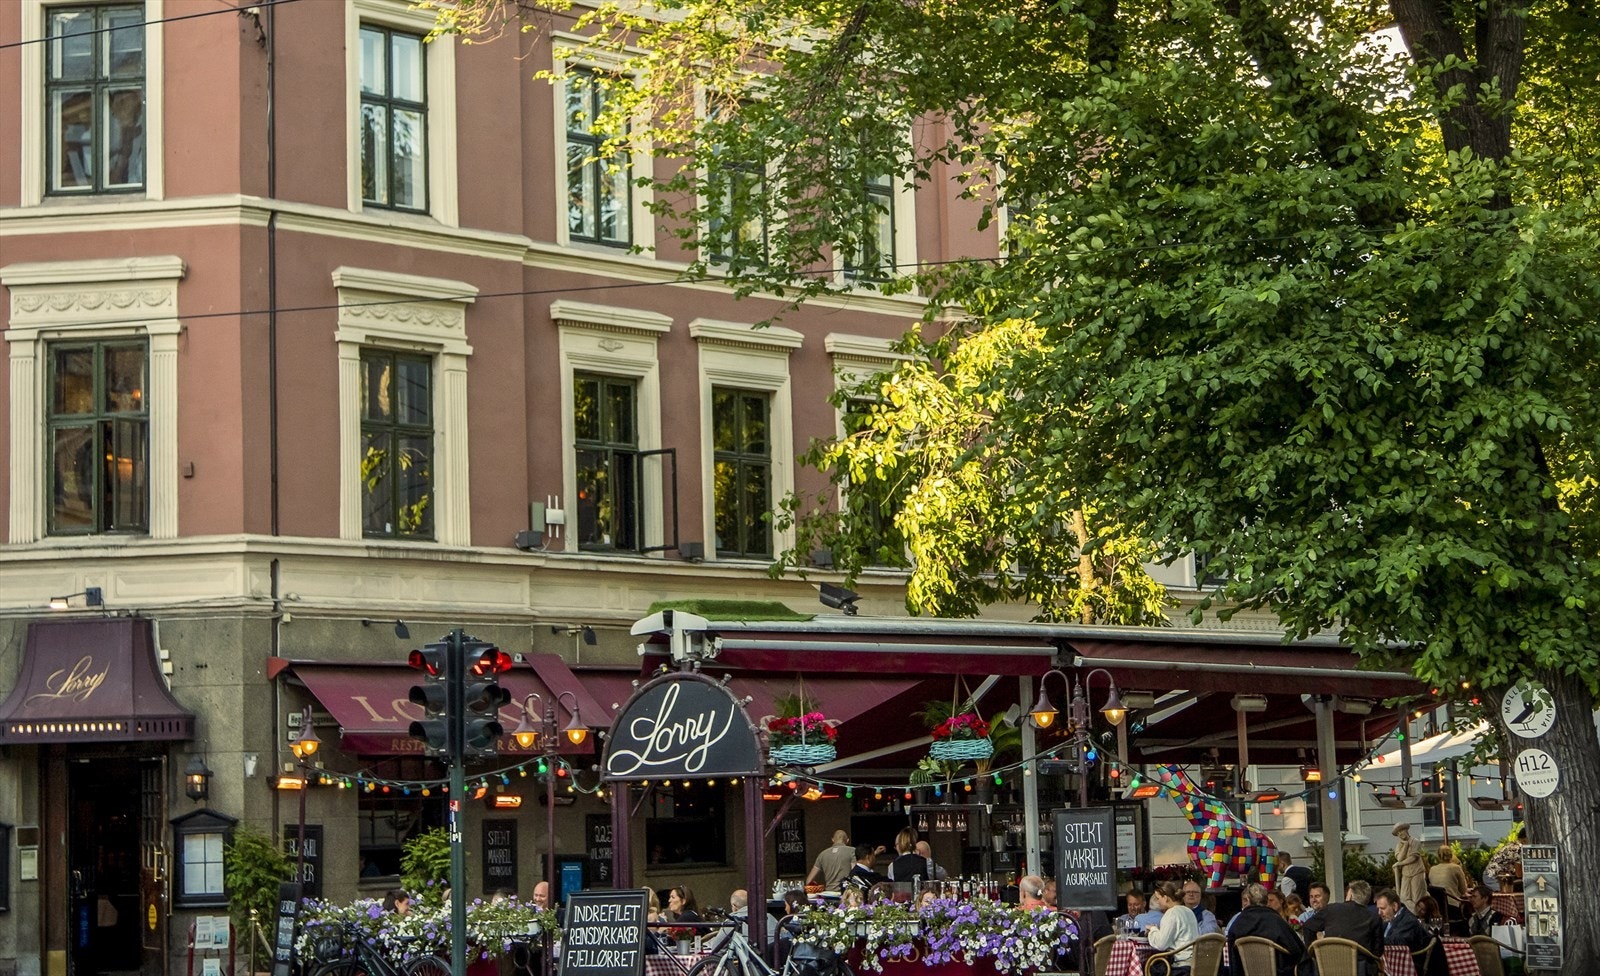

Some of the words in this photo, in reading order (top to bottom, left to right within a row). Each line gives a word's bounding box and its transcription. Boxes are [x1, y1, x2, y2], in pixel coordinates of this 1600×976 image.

[25, 655, 111, 710] Lorry
[606, 682, 735, 776] Lorry
[507, 739, 518, 752] &
[1518, 753, 1551, 773] H12
[1532, 777, 1558, 786] GALLERY
[783, 829, 800, 841] TYSK
[1065, 821, 1103, 845] STEKT
[1064, 847, 1107, 869] MAKRELL
[1526, 848, 1552, 859] EMBLA
[1065, 871, 1108, 887] AGURKSALAT
[573, 904, 641, 923] INDREFILET
[566, 949, 638, 968] FJELLØRRET
